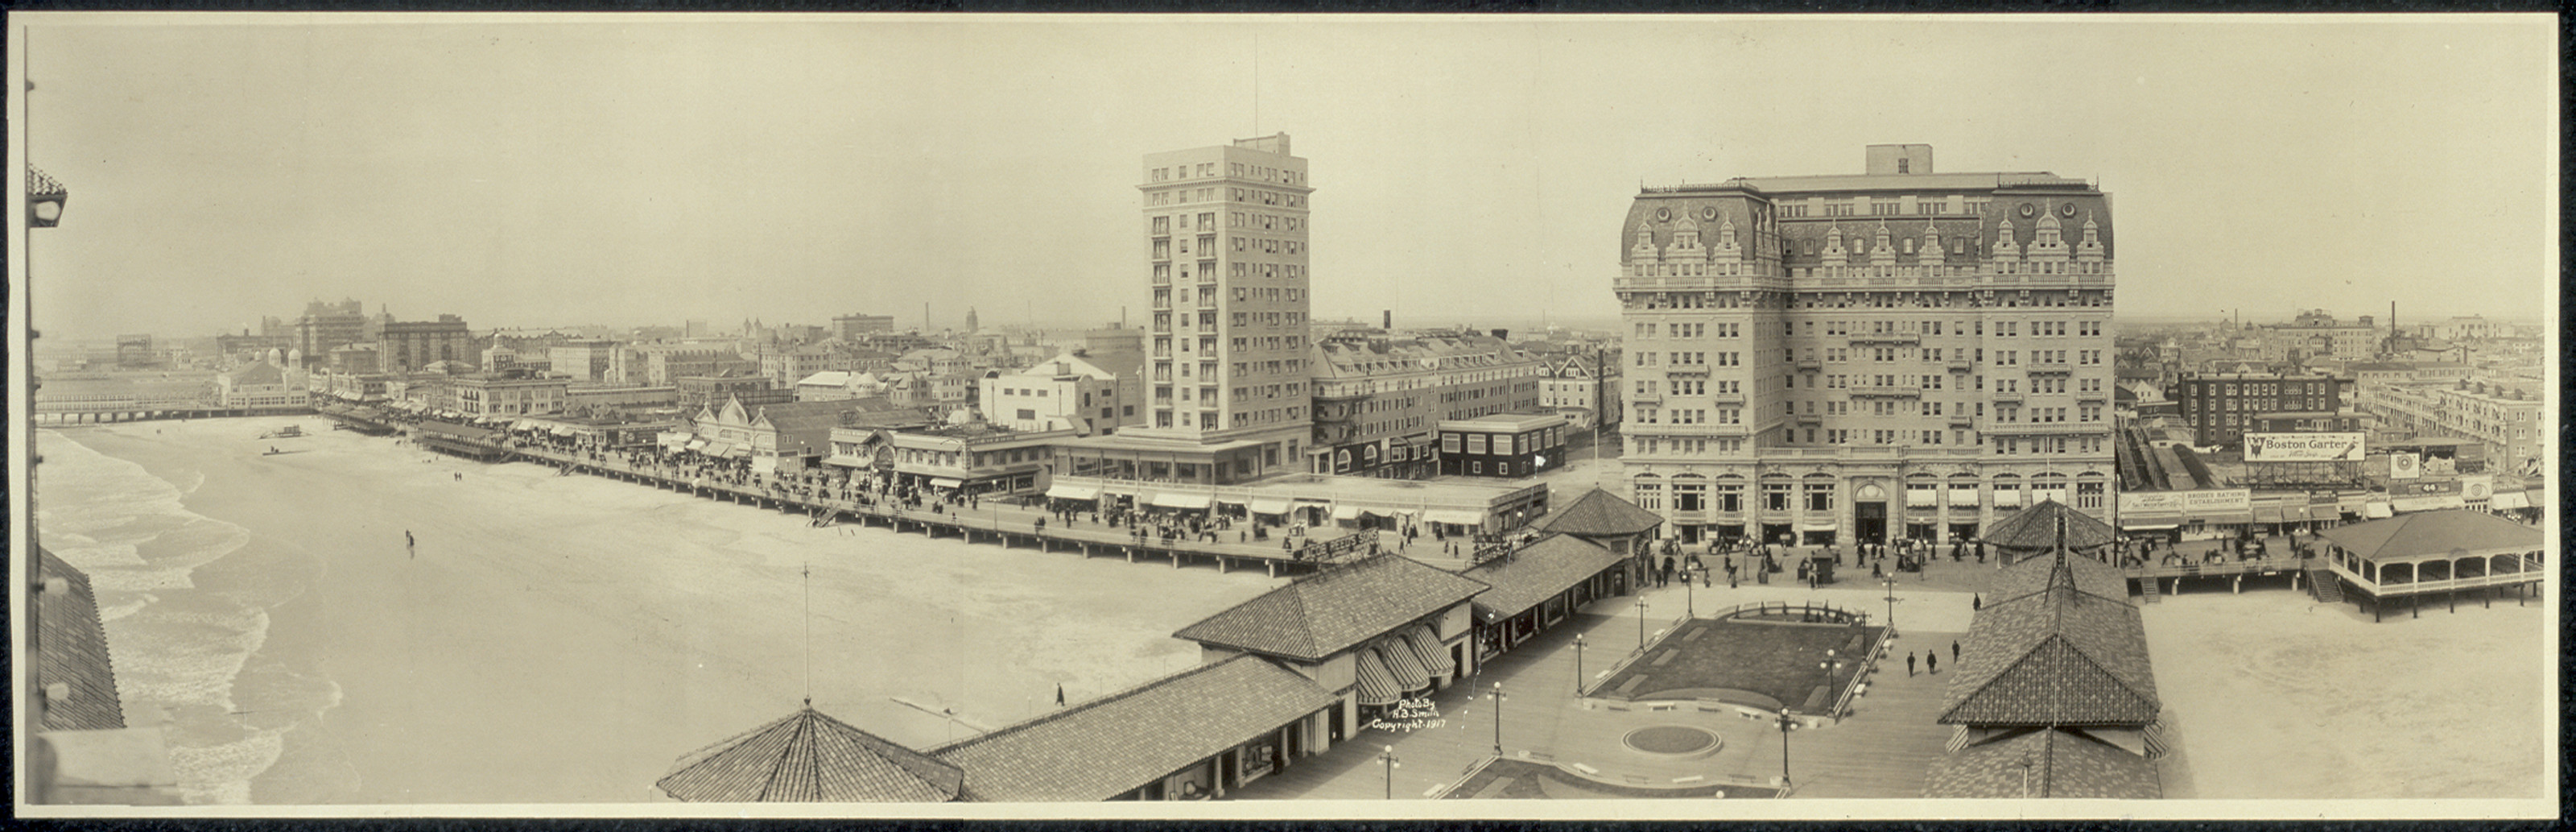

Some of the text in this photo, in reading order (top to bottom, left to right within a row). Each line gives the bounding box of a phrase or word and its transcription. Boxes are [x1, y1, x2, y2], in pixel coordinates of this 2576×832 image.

[2266, 440, 2347, 449] Boston Garter
[1358, 528, 1378, 543] SONS
